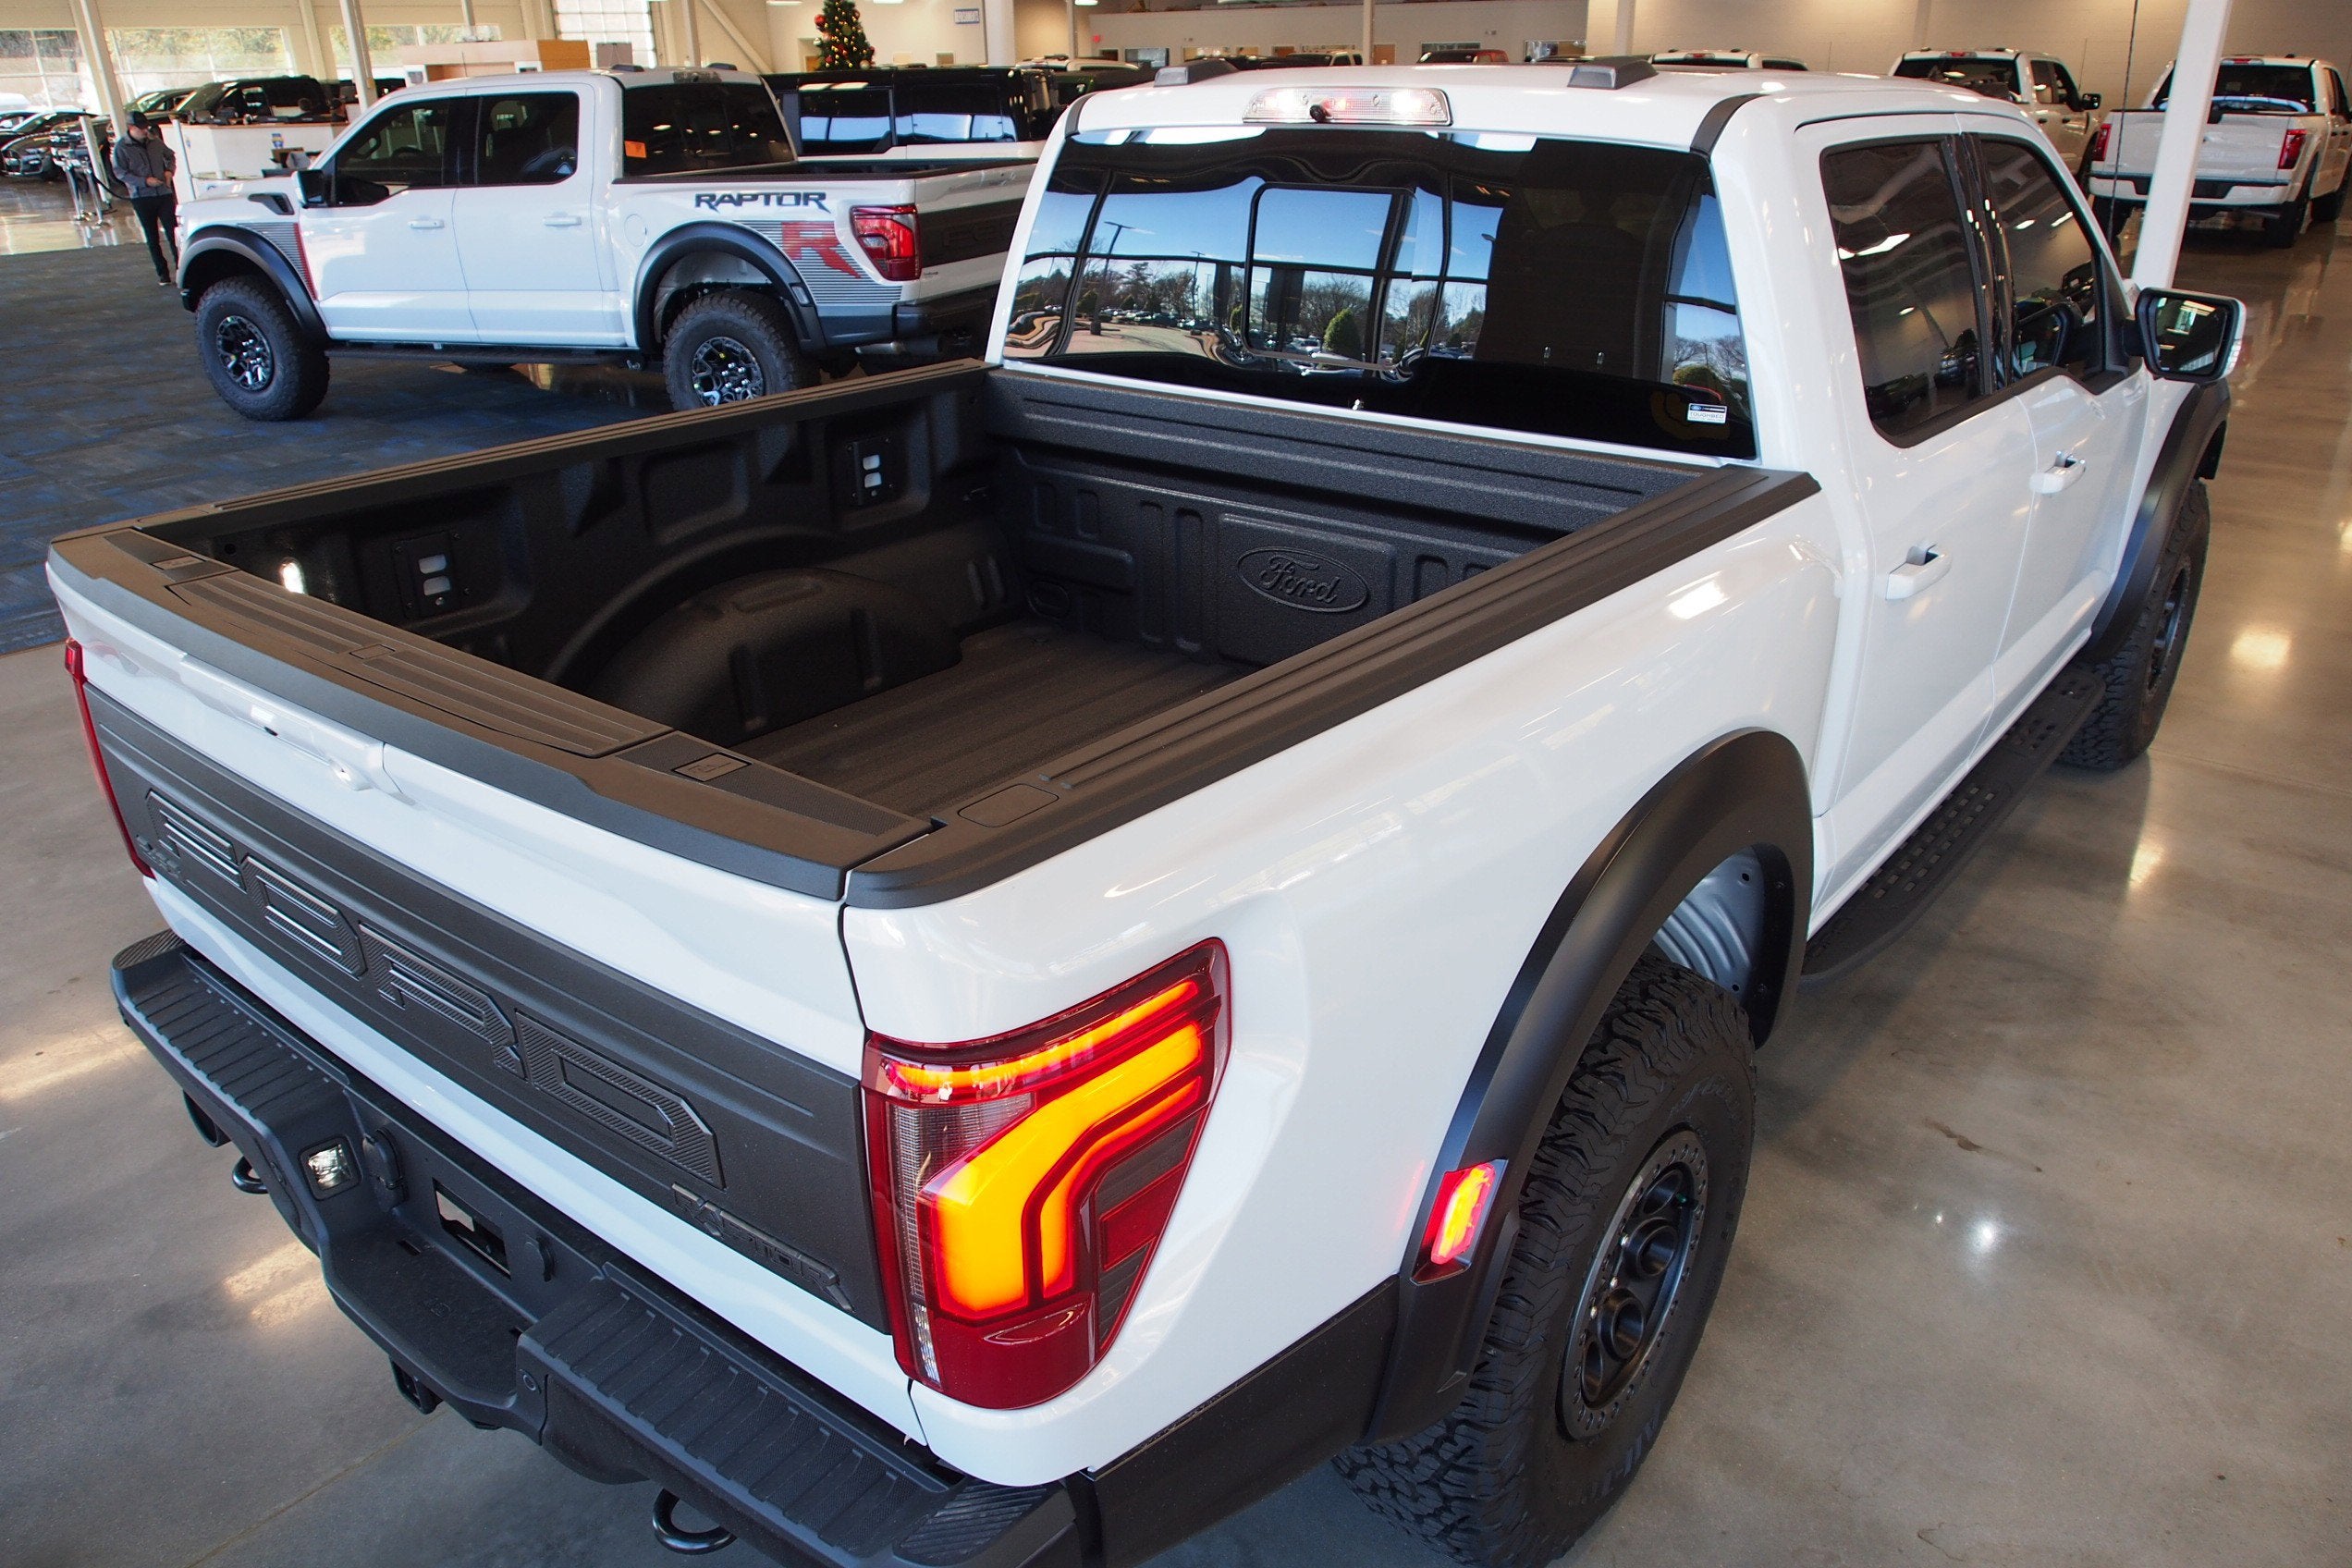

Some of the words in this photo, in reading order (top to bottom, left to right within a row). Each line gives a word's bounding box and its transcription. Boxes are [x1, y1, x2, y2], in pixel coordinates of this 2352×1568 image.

[695, 191, 830, 214] RAPTOR
[1259, 554, 1341, 604] Ford
[145, 789, 727, 1191] FORD
[671, 1181, 856, 1314] RAPTOR
